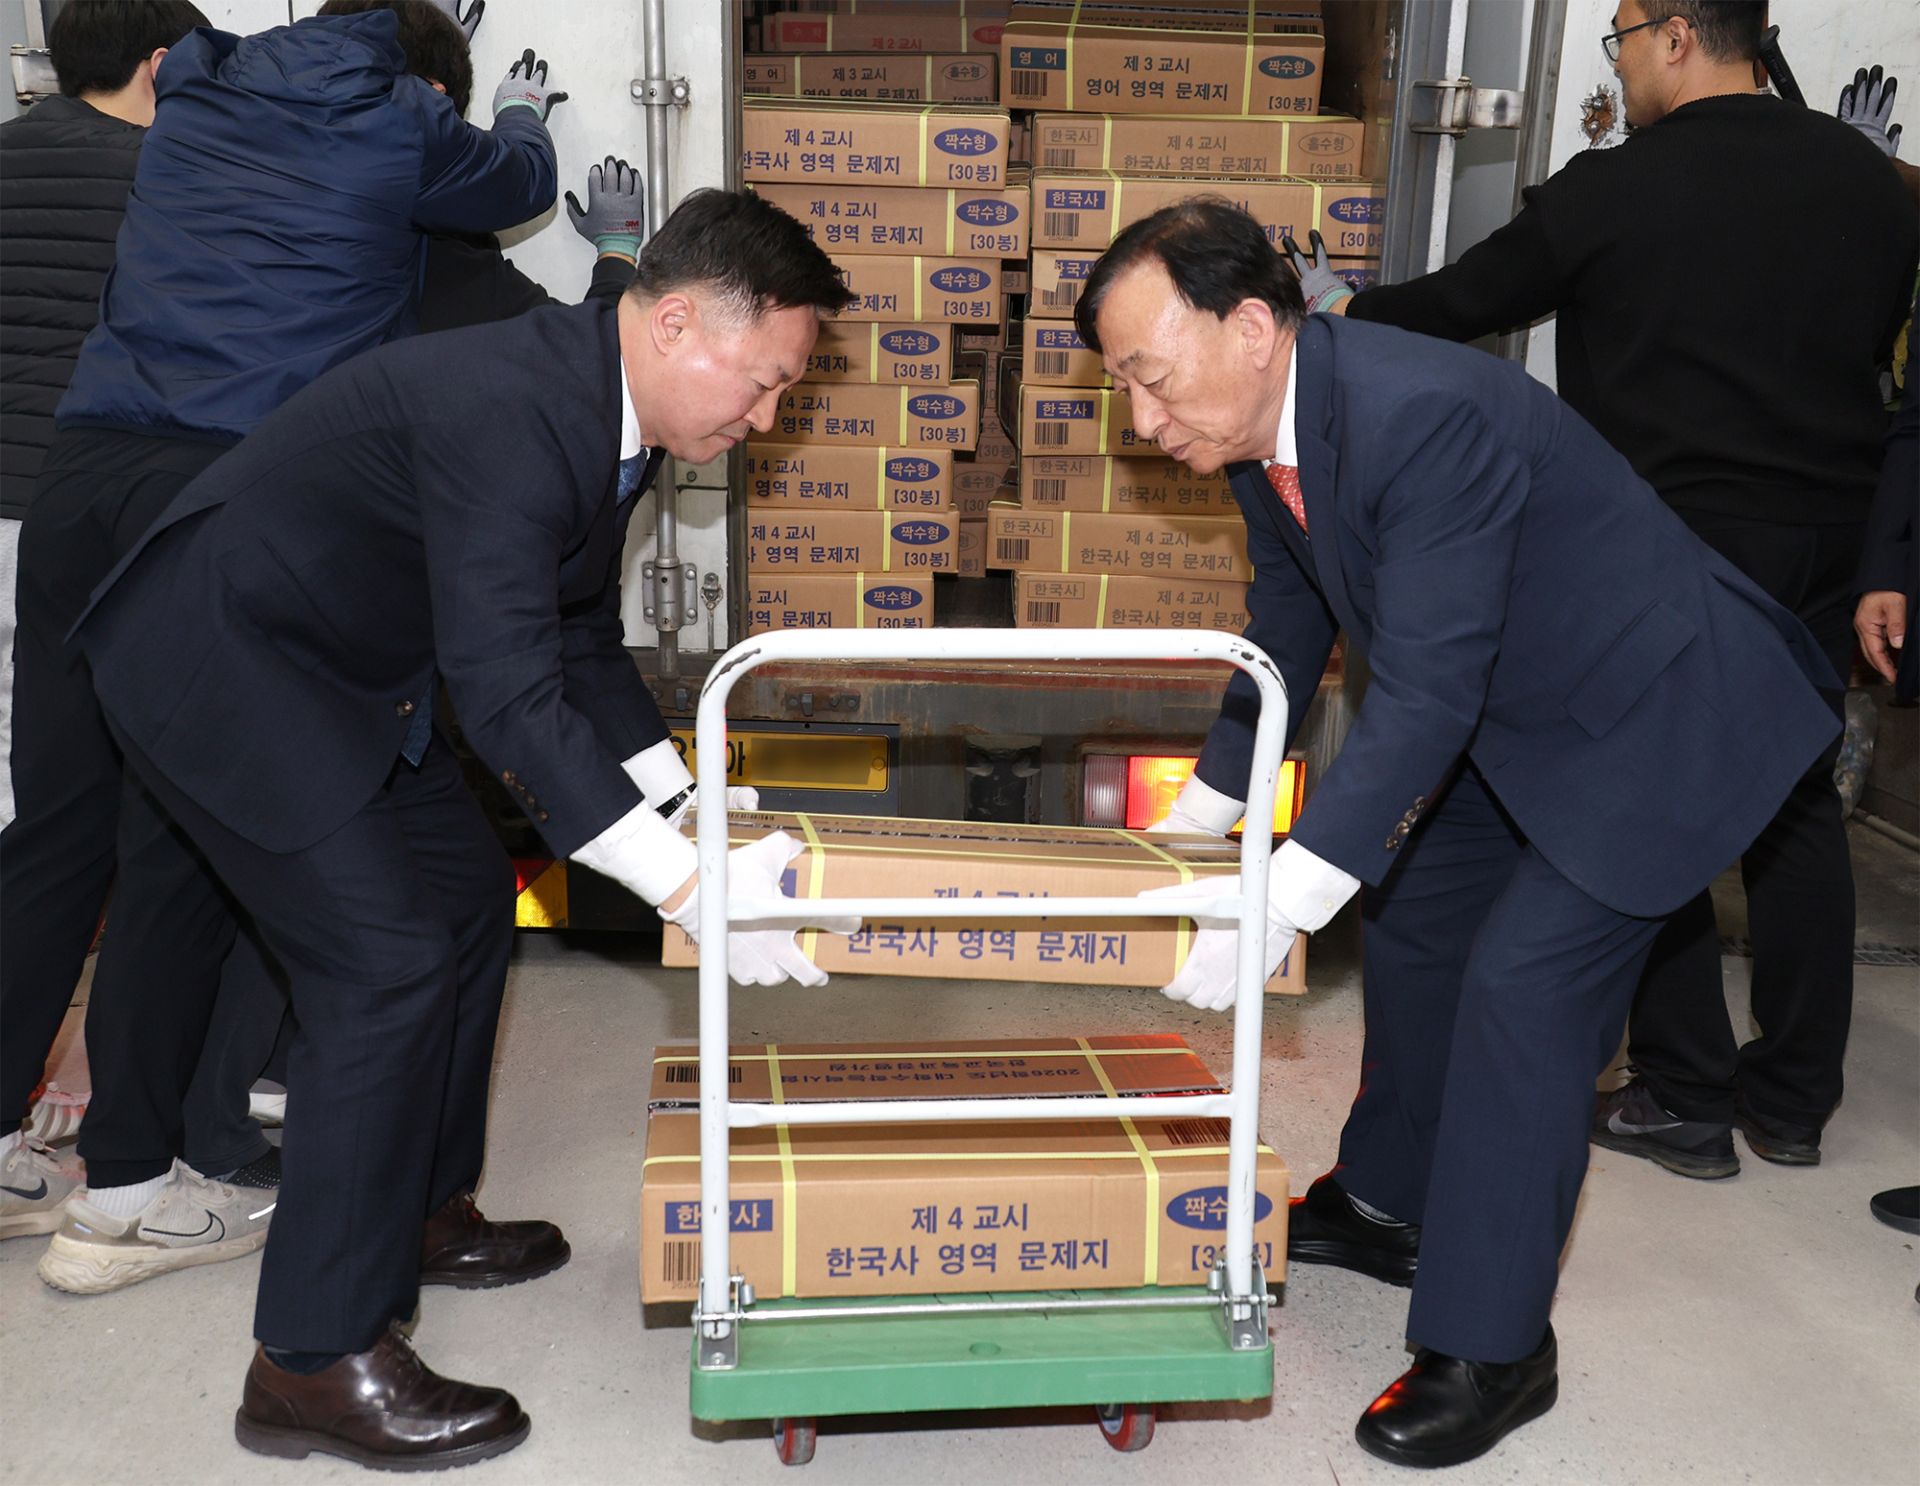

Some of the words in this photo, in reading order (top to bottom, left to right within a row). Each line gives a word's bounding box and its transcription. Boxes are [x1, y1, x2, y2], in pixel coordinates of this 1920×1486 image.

[888, 37, 895, 49] 2
[1124, 56, 1139, 72] 제
[1144, 56, 1153, 71] 3
[1158, 56, 1190, 74] 교시
[1267, 58, 1306, 75] 짝수형
[833, 67, 845, 80] 제
[849, 68, 857, 79] 3
[862, 67, 887, 81] 교시
[1086, 78, 1120, 97] 영어
[1130, 79, 1165, 99] 영역
[1175, 82, 1228, 101] 문제지
[784, 129, 800, 146] 제
[805, 130, 815, 145] 4
[820, 129, 853, 148] 교시
[944, 133, 987, 151] 짝수형
[1050, 129, 1093, 144] 한국사
[1166, 135, 1181, 150] 제
[1185, 135, 1194, 149] 4
[1198, 135, 1227, 152] 교시
[1307, 136, 1345, 151] 홀수형
[800, 153, 835, 173] 영역
[847, 154, 900, 175] 문제지
[1124, 154, 1171, 171] 한국사
[1052, 191, 1099, 208] 한국사
[810, 200, 825, 217] 제
[831, 202, 840, 216] 4
[845, 201, 877, 219] 교시
[967, 204, 1009, 221] 짝수형
[826, 224, 860, 243] 영역
[871, 226, 923, 245] 문제지
[940, 272, 981, 288] 짝수형
[889, 335, 930, 351] 짝수형
[786, 396, 795, 409] 4
[800, 396, 831, 412] 교시
[916, 399, 956, 415] 짝수형
[1042, 401, 1088, 418] 한국사
[781, 416, 814, 434] 영역
[825, 418, 875, 436] 문제지
[760, 460, 769, 473] 4
[774, 459, 805, 475] 교시
[890, 462, 930, 478] 짝수형
[1040, 459, 1084, 474] 한국사
[1164, 465, 1178, 481] 제
[756, 480, 788, 497] 영역
[799, 481, 849, 499] 문제지
[1117, 486, 1167, 504] 한국사
[1177, 487, 1209, 505] 영역
[752, 525, 766, 541] 제
[771, 527, 780, 539] 4
[786, 525, 816, 541] 교시
[900, 526, 940, 541] 짝수형
[1003, 519, 1047, 534] 한국사
[1126, 530, 1140, 545] 제
[1145, 532, 1154, 544] 4
[1159, 531, 1190, 548] 교시
[766, 547, 799, 563] 영역
[809, 547, 860, 564] 문제지
[1080, 548, 1130, 567] 한국사
[1140, 551, 1172, 569] 영역
[1183, 553, 1233, 572] 문제지
[757, 590, 787, 606] 교시
[873, 591, 912, 605] 짝수형
[1034, 582, 1079, 597] 한국사
[1158, 590, 1171, 605] 제
[1176, 592, 1185, 603] 4
[1190, 591, 1221, 606] 교시
[782, 611, 832, 628] 문제지
[1111, 609, 1161, 627] 한국사
[1170, 610, 1202, 627] 영역
[957, 928, 1017, 961] 영역
[1036, 931, 1128, 965] 문제지
[676, 1202, 762, 1230] 한사
[911, 1205, 939, 1234] 제
[948, 1207, 964, 1231] 4
[974, 1202, 1030, 1232] 교시
[826, 1244, 920, 1278] 한국사
[939, 1243, 998, 1275] 영역
[1017, 1238, 1110, 1271] 문제지
